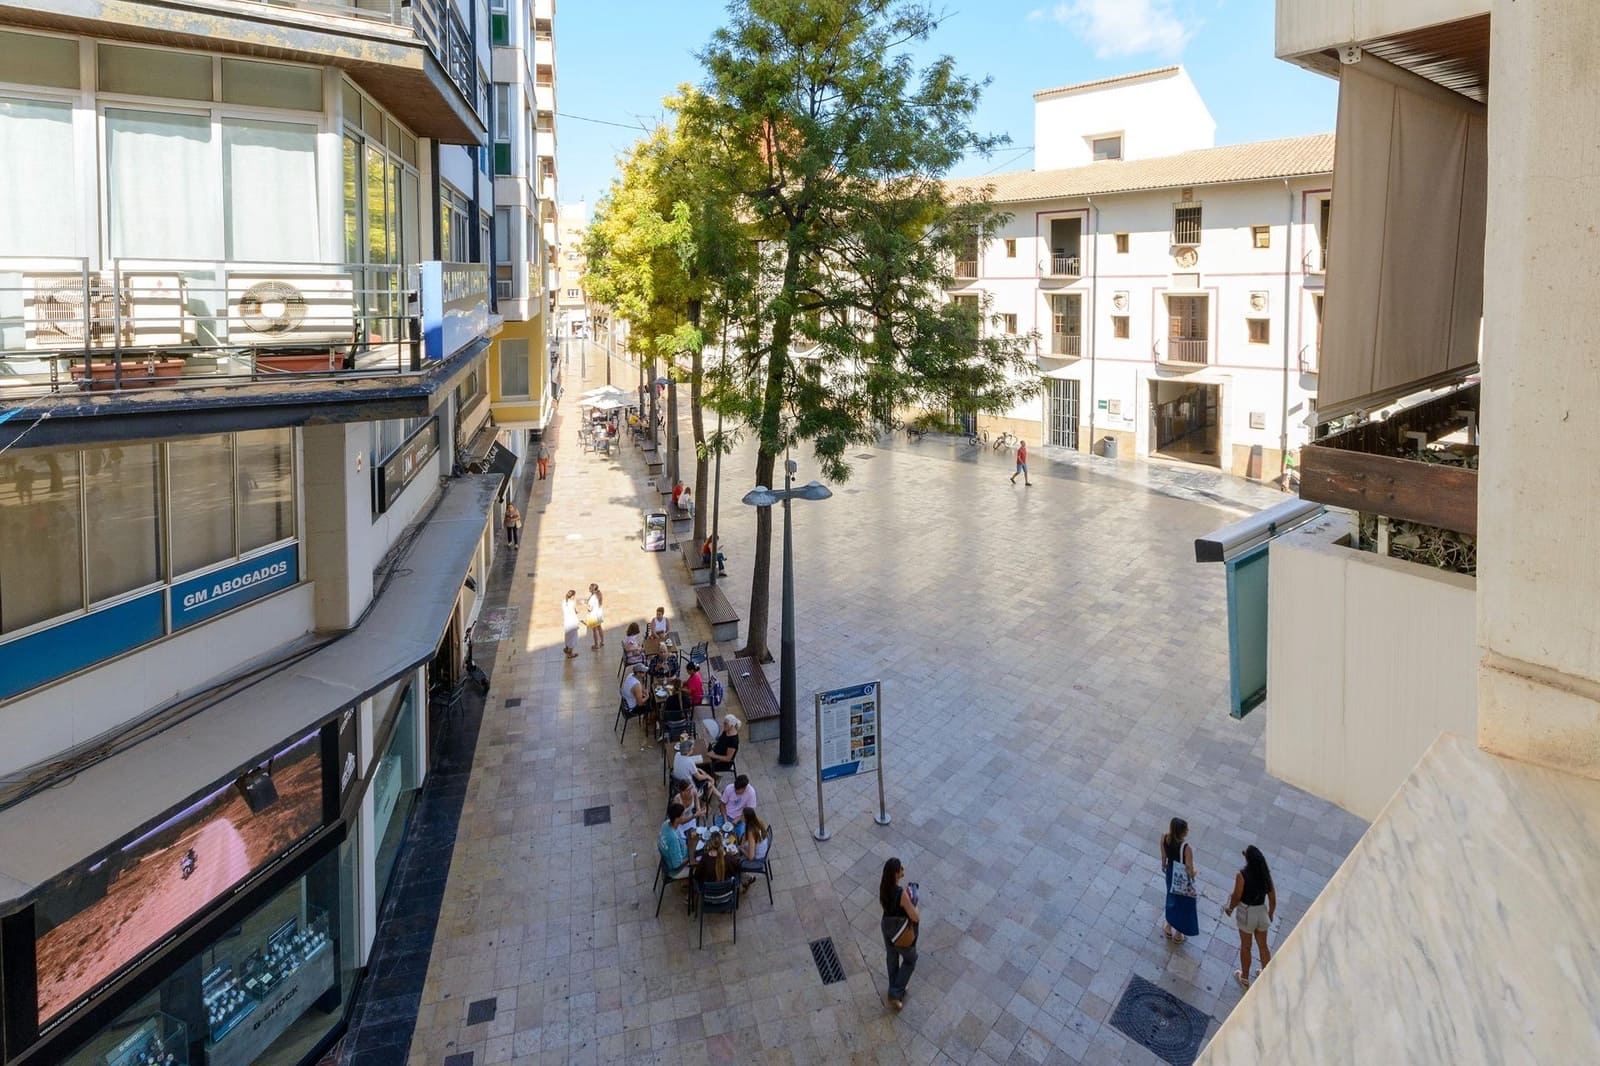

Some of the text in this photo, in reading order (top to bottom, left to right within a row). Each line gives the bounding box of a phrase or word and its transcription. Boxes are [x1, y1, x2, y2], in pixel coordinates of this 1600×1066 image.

[183, 561, 287, 608] GM ABOGADOS
[253, 984, 298, 1031] G-SHOCK
